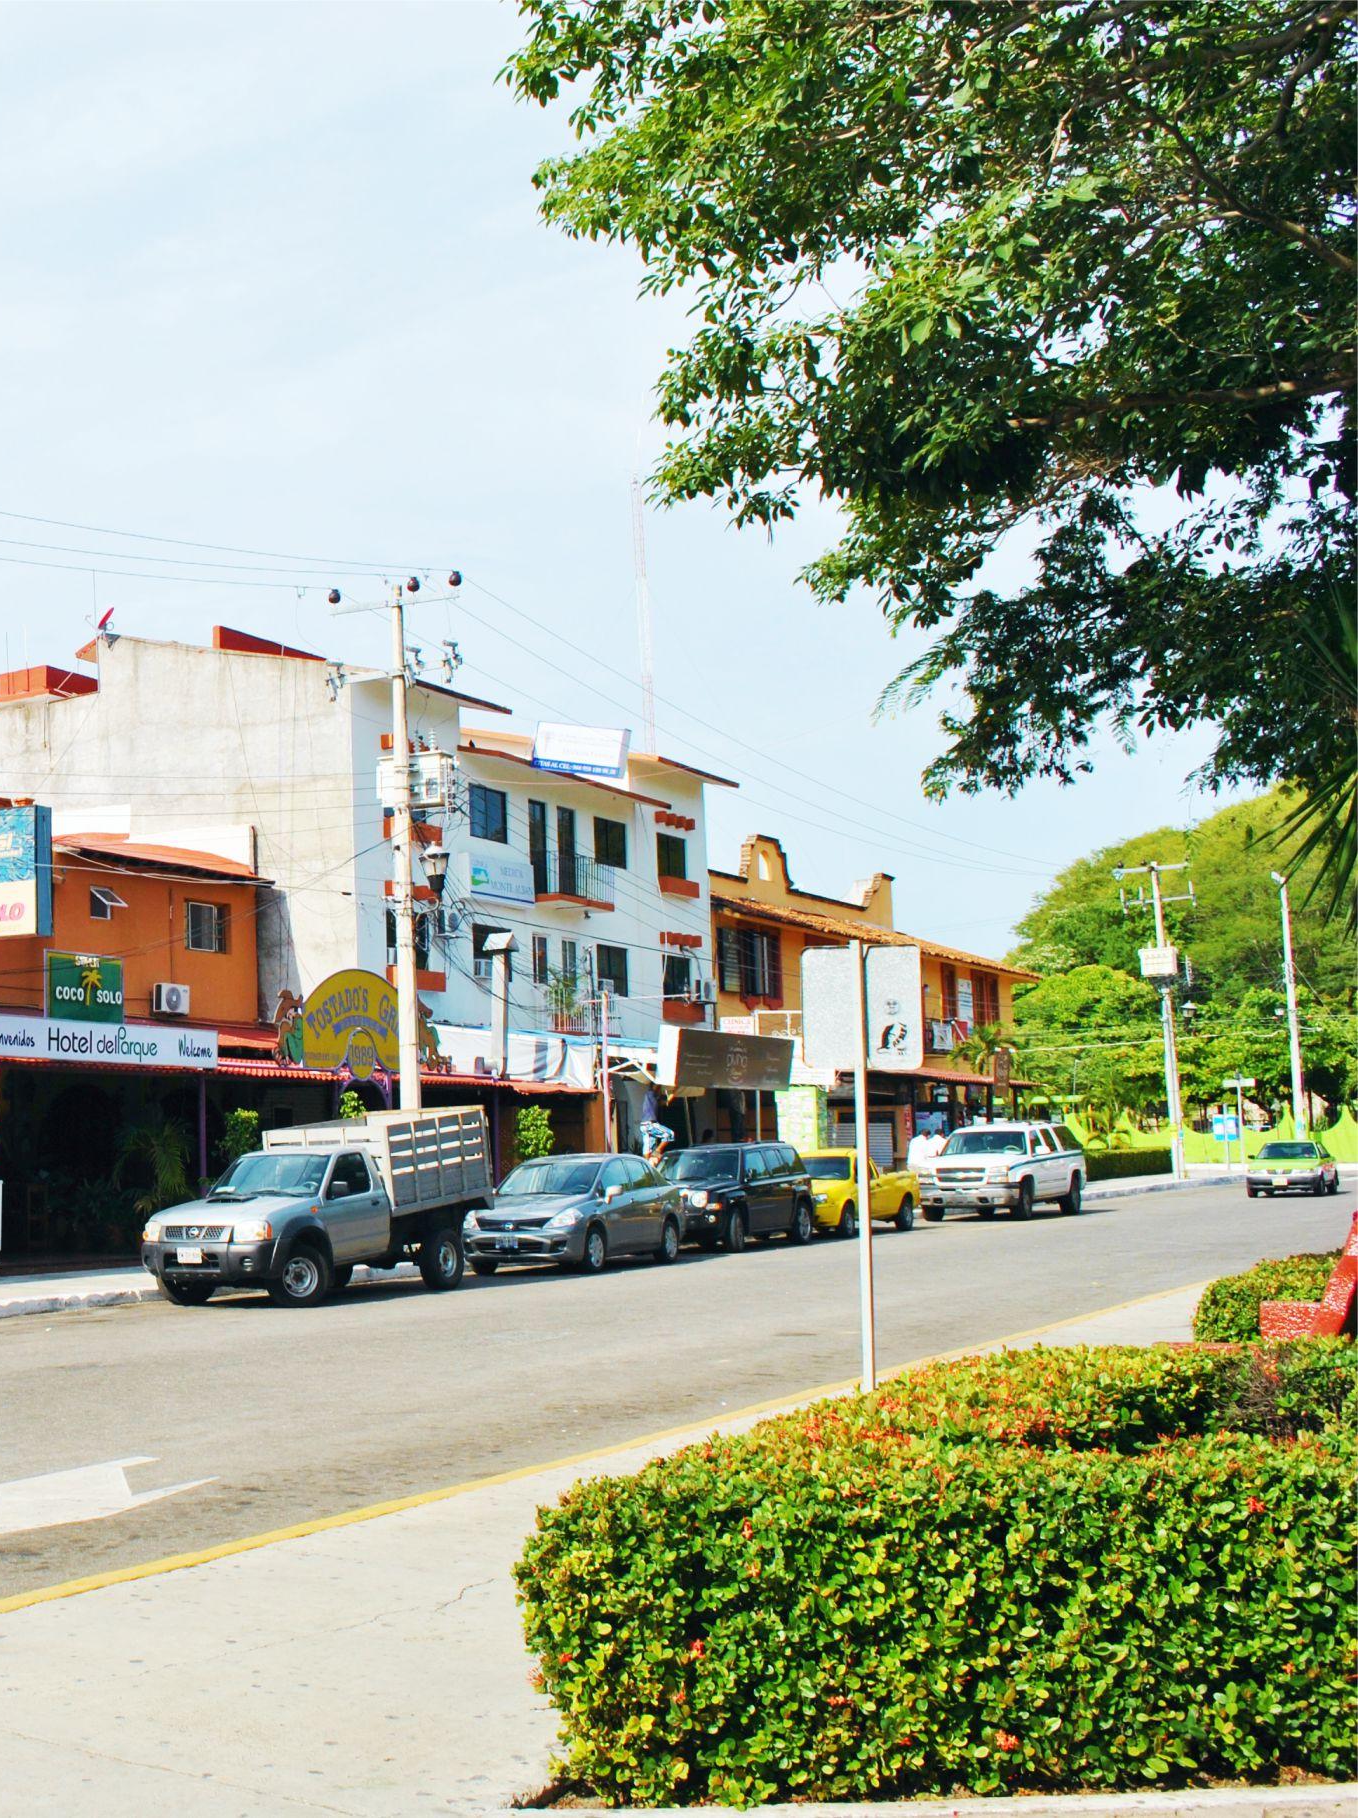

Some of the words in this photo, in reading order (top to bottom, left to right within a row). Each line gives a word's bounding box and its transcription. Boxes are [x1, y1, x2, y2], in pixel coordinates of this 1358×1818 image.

[55, 985, 85, 1002] COCO
[96, 989, 123, 1005] SOLO
[306, 985, 369, 1040] TOSTADO'S
[48, 1027, 93, 1054] Hotel
[178, 1034, 213, 1059] Welcome
[351, 1045, 374, 1066] 1989
